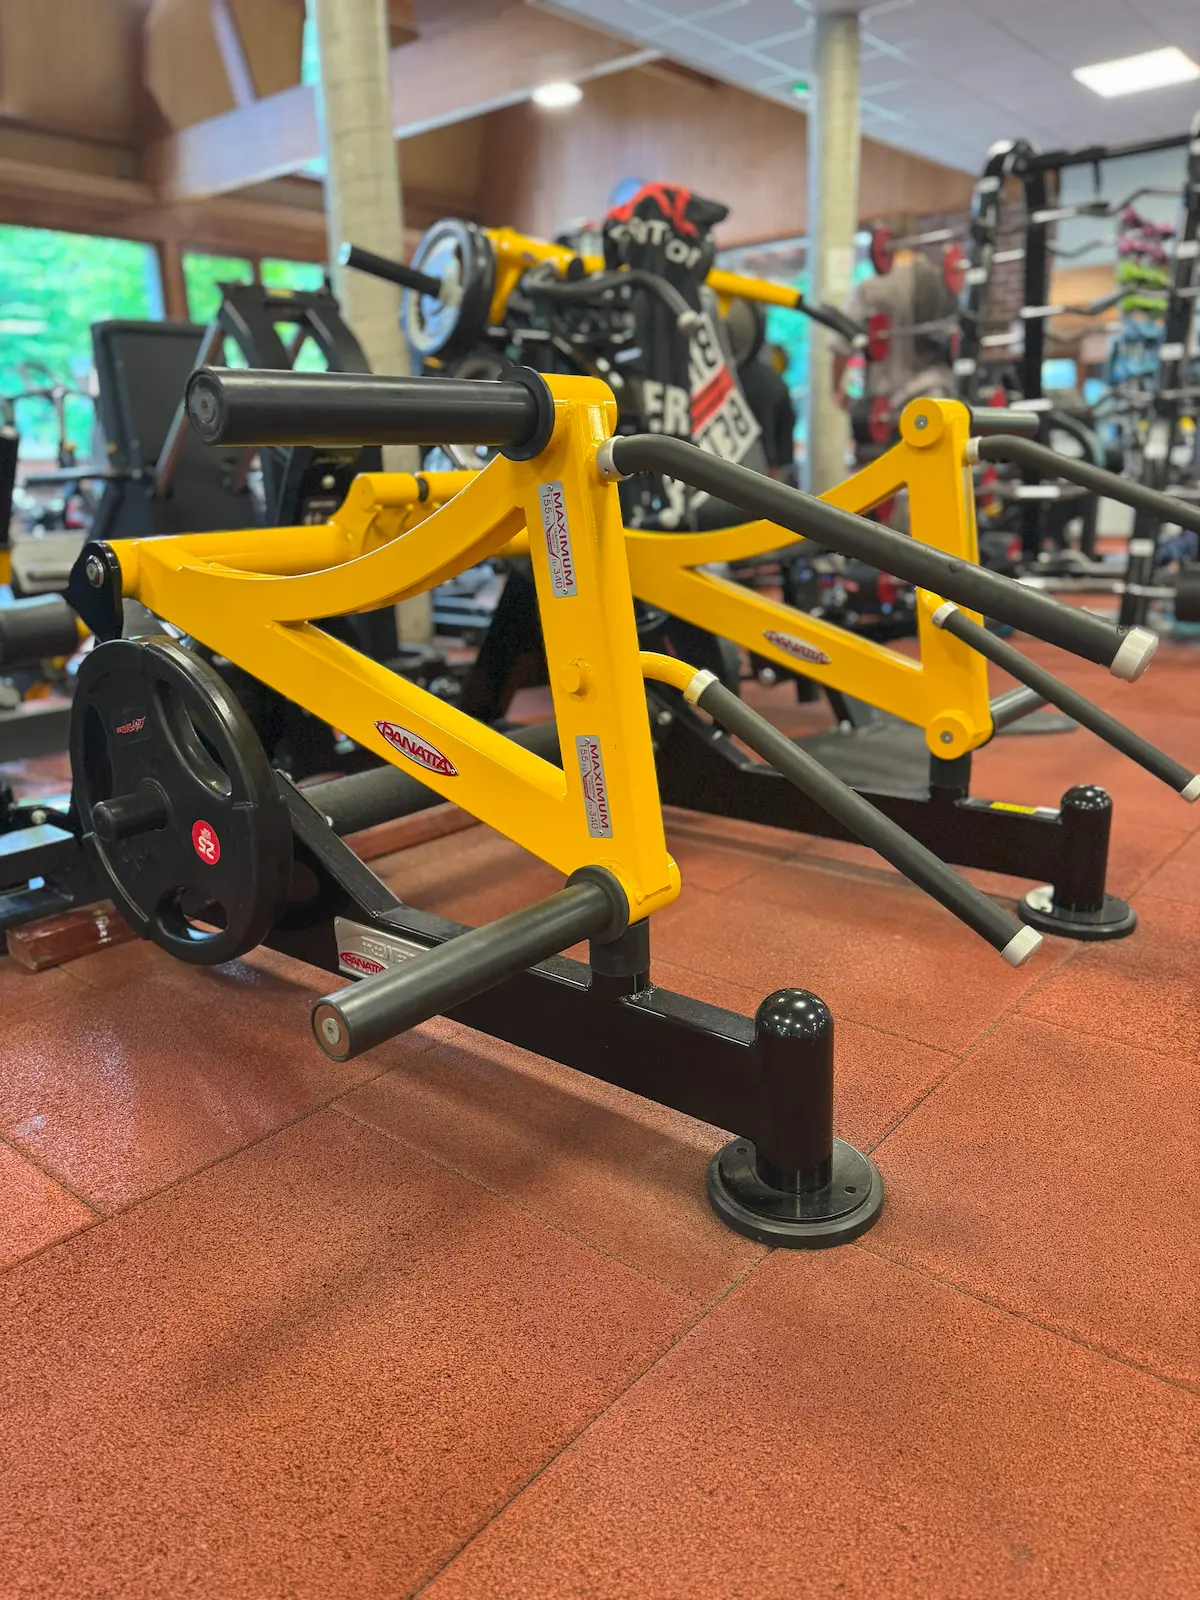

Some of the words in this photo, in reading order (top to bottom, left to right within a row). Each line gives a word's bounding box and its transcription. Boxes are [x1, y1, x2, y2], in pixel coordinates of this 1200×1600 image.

[542, 493, 553, 515] 155
[553, 491, 573, 586] MAXIMUM
[553, 568, 563, 589] 340
[381, 720, 451, 775] PANATTA
[580, 743, 589, 763] 155
[590, 744, 609, 829] MAXIMUM
[589, 811, 599, 830] 340
[198, 835, 215, 860] 25
